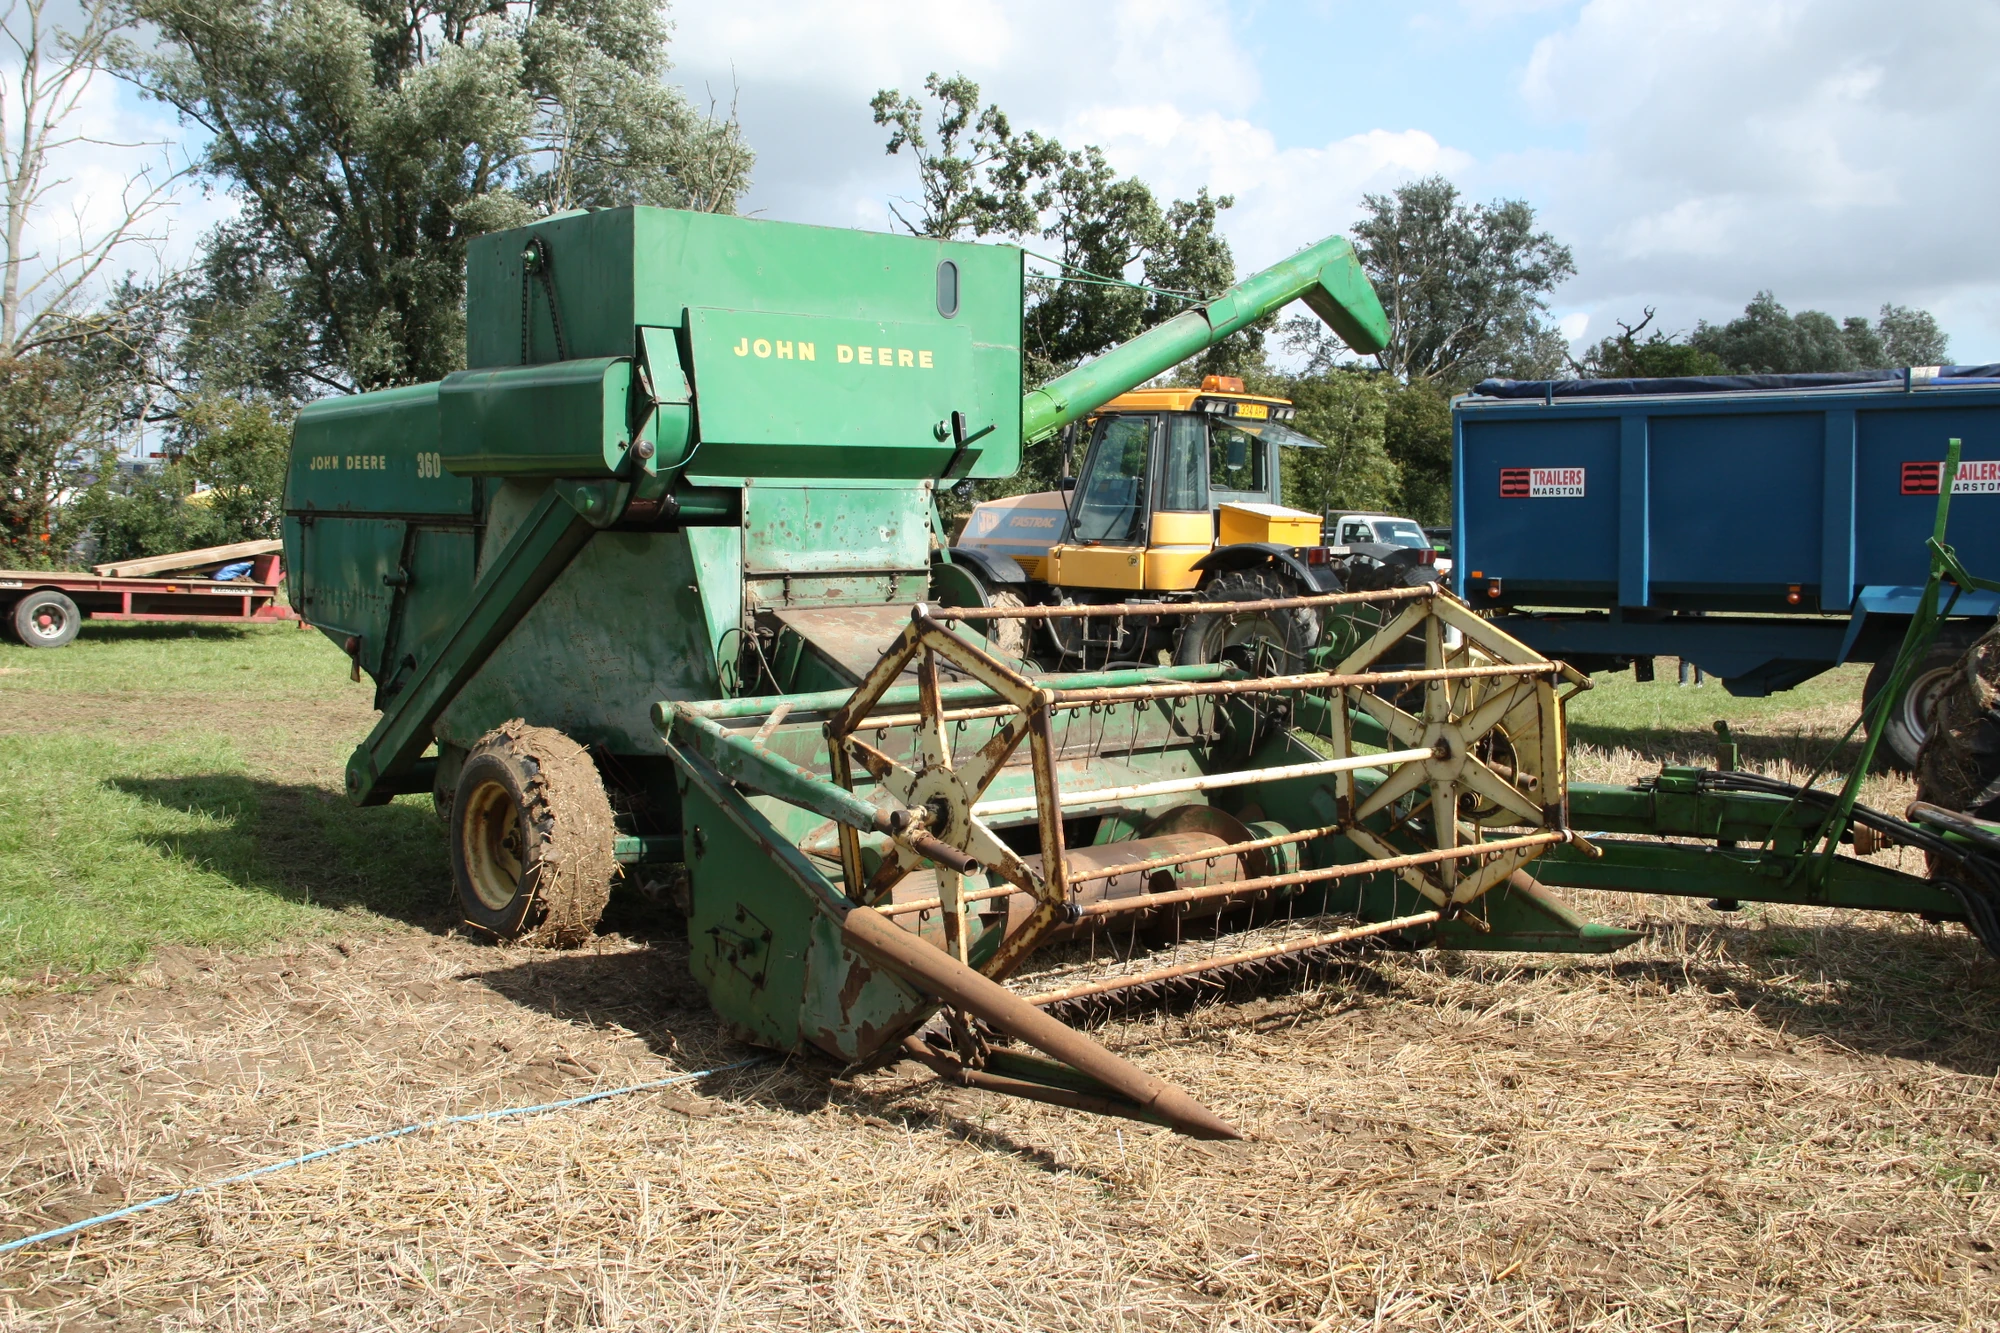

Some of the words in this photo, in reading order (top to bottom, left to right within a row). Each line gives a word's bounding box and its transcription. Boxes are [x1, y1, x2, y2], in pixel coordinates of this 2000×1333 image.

[733, 337, 816, 361] JOHN
[837, 344, 934, 369] DEERE
[310, 455, 339, 471] JOHN
[346, 455, 386, 470] DEERE
[417, 452, 441, 478] 360
[1533, 470, 1582, 485] TRAILERS
[1532, 487, 1583, 495] MARSTON
[1009, 516, 1057, 528] FASTRAC
